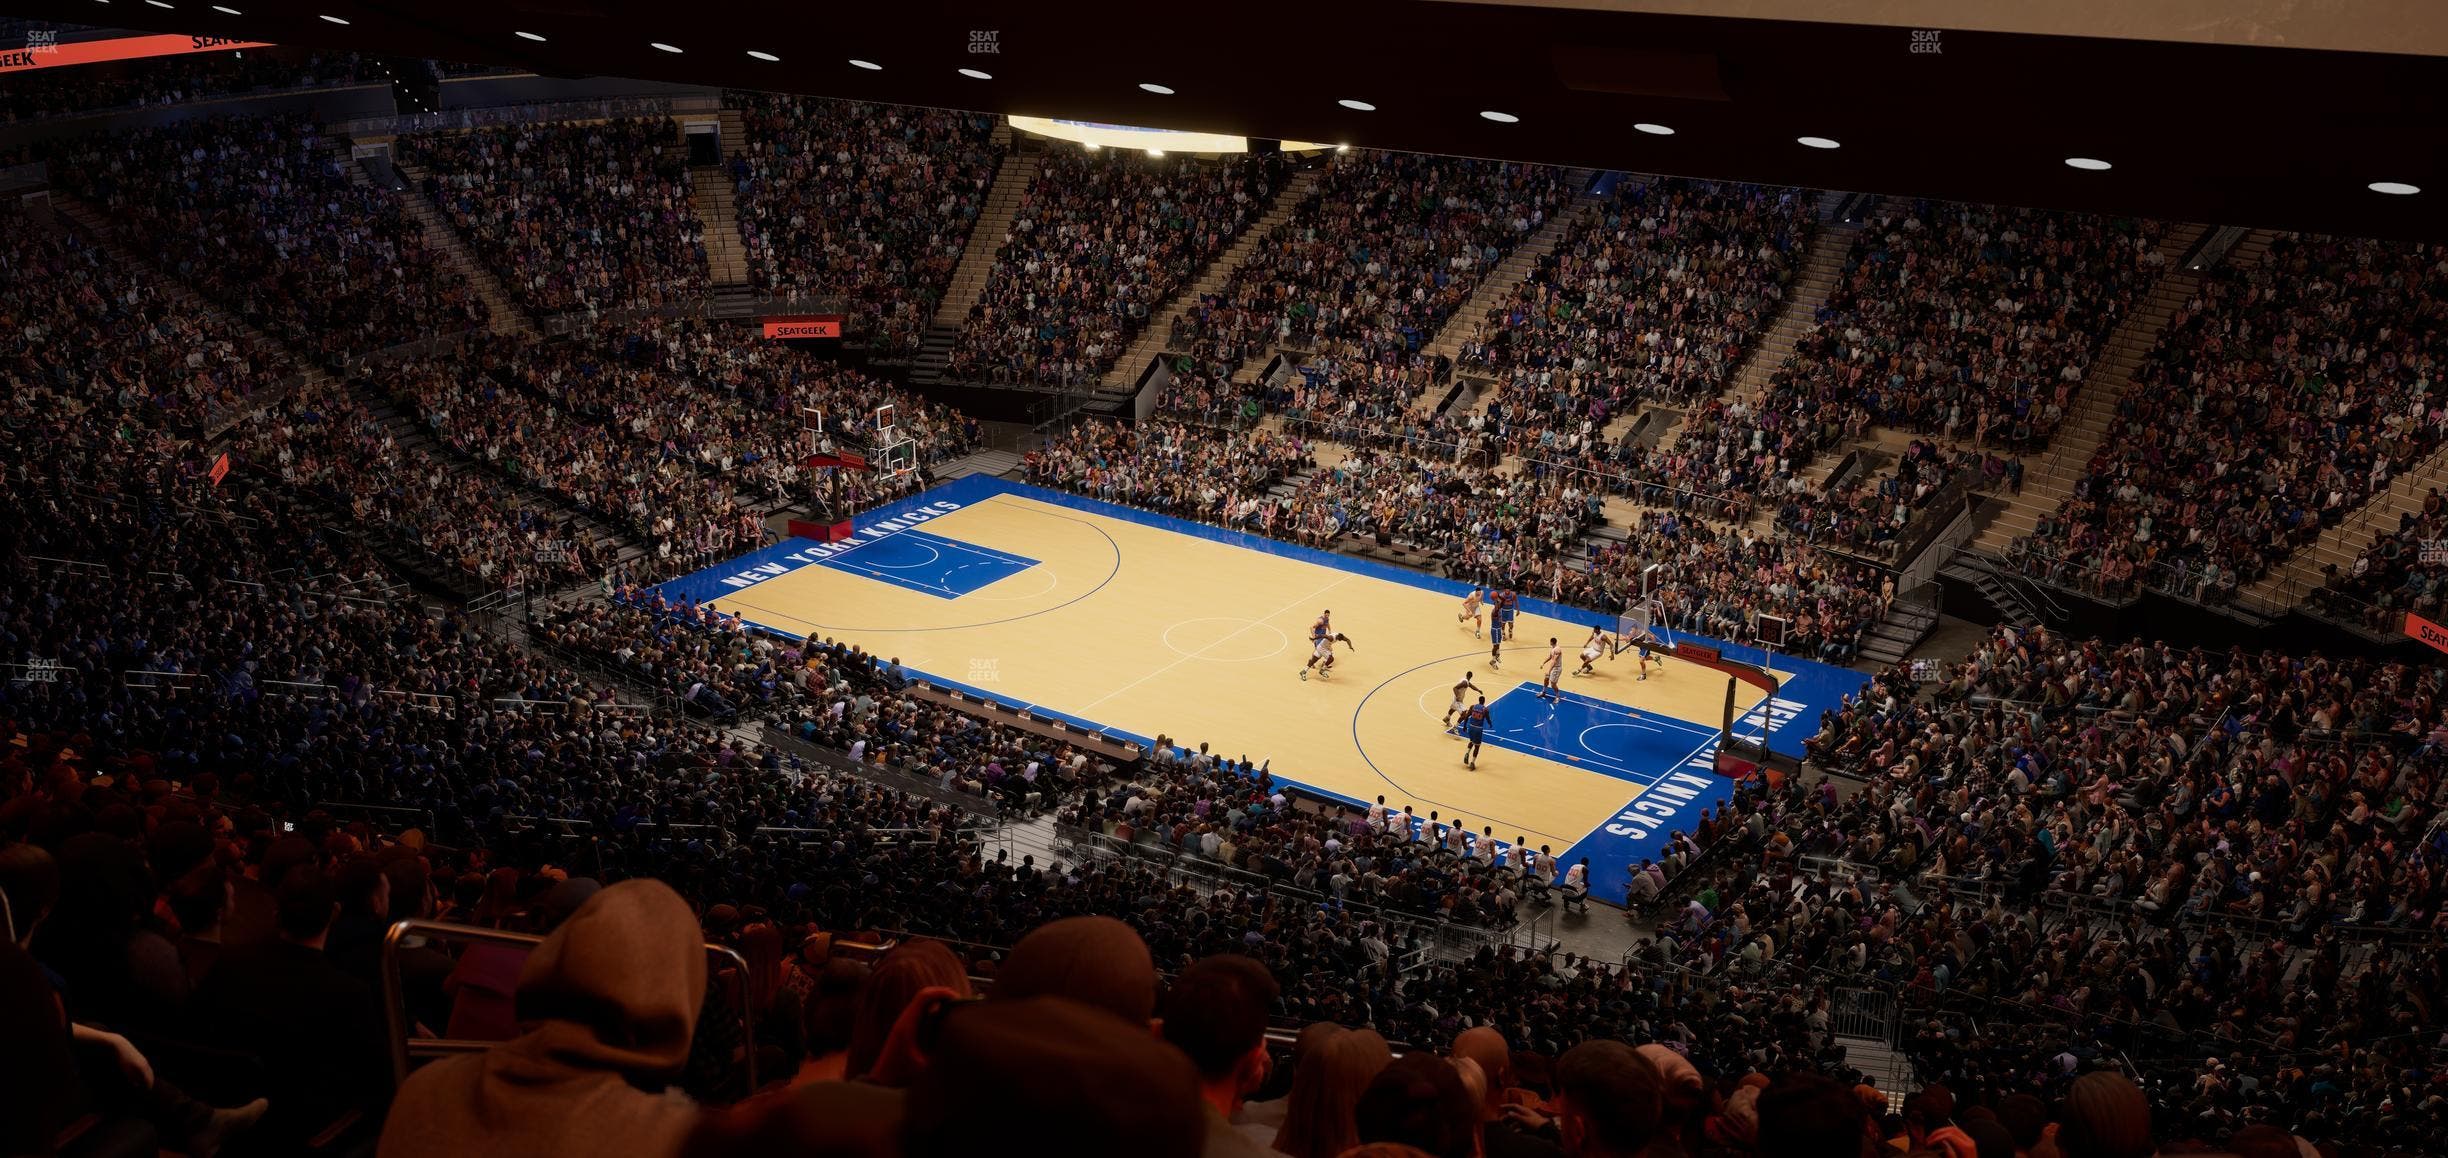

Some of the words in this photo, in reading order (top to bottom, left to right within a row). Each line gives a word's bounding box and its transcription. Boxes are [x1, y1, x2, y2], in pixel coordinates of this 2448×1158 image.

[0, 52, 36, 67] EEK
[777, 326, 827, 336] SEATGEEK
[721, 561, 790, 588] NEW
[784, 537, 868, 563] YORK
[858, 501, 962, 538] KNICKS
[2420, 625, 2448, 648] SEAT
[1743, 697, 1808, 732] NEW
[1605, 771, 1713, 840] KNICKS
